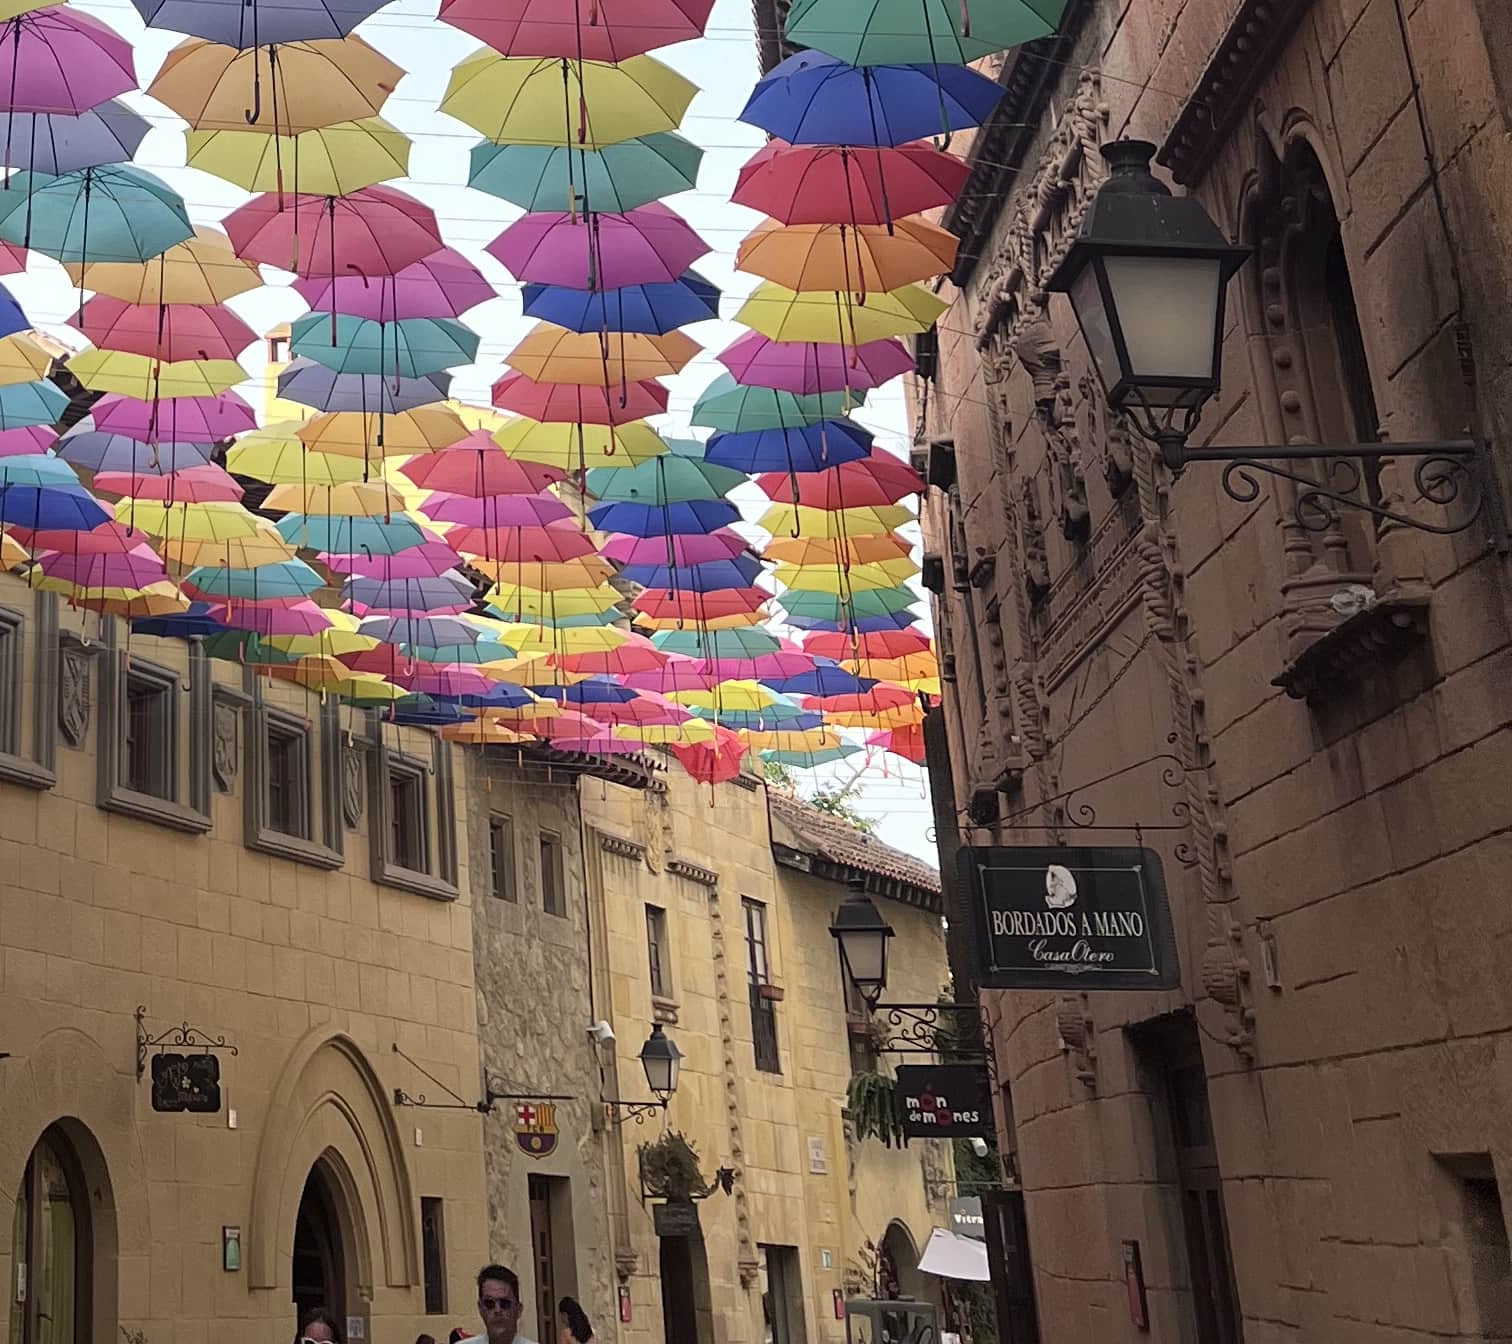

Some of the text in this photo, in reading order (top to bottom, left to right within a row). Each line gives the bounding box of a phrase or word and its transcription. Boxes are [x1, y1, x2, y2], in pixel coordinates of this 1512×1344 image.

[992, 911, 1144, 937] BORDADOS A MANO
